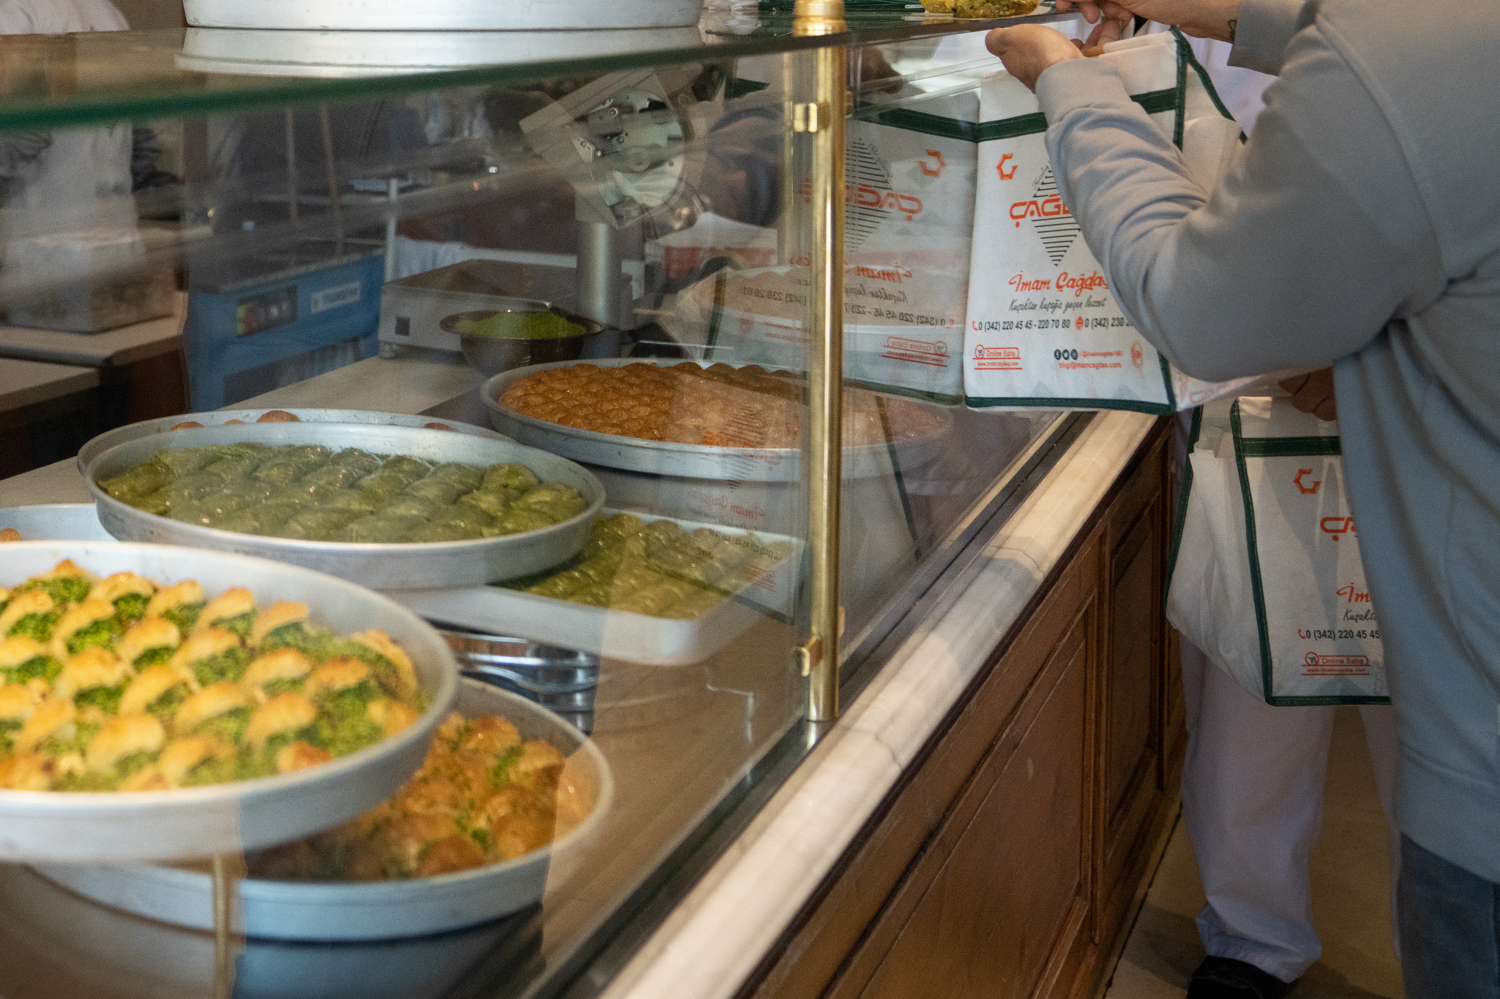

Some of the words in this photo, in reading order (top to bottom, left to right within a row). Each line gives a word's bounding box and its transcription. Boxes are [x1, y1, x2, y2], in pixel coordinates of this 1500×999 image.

[1009, 270, 1051, 292] İmam
[978, 321, 983, 331] 0
[984, 320, 1001, 333] (342)
[1002, 320, 1014, 331] 220
[1015, 320, 1024, 330] 45
[1024, 320, 1033, 330] 45
[1038, 319, 1049, 329] 220
[1051, 319, 1060, 329] 70
[1061, 318, 1071, 329] 80
[1085, 317, 1089, 327] 0
[1091, 317, 1109, 330] (342)
[1110, 317, 1125, 328] 230
[1305, 630, 1311, 639] 0
[1313, 629, 1336, 641] (342)
[1338, 630, 1353, 639] 220
[1356, 630, 1368, 639] 45
[1369, 630, 1381, 639] 45
[1322, 657, 1345, 665] Online
